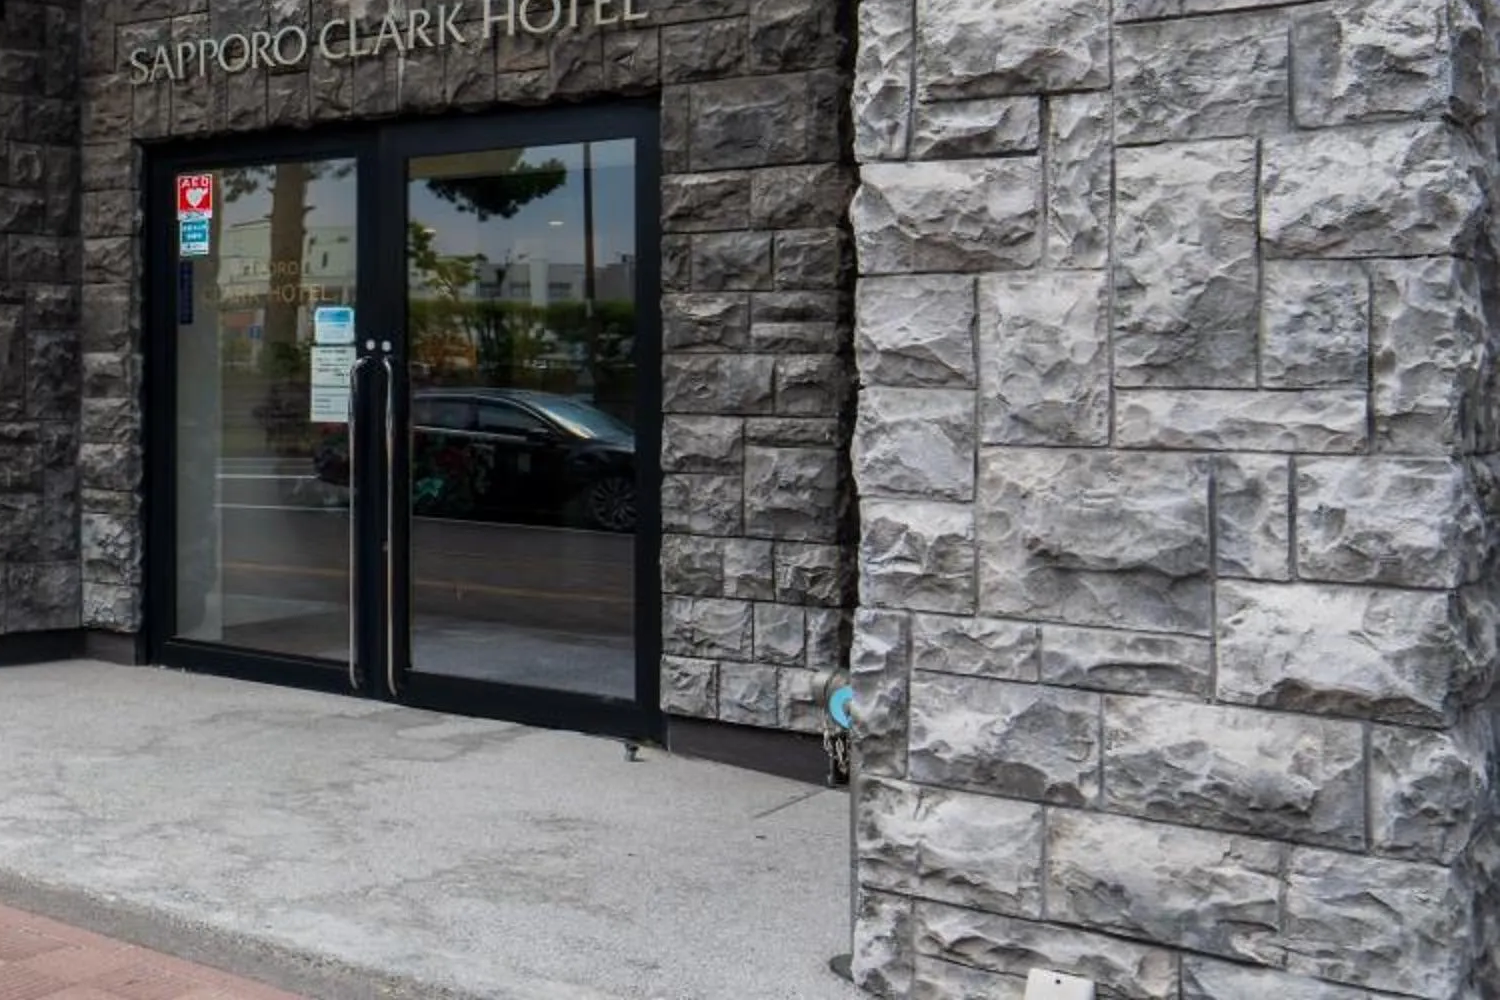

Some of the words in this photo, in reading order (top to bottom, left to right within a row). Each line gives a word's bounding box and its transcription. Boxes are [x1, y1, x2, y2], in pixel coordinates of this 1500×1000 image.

[129, 25, 307, 86] SAPPORO
[319, 2, 466, 59] CLARK
[181, 176, 209, 188] AED
